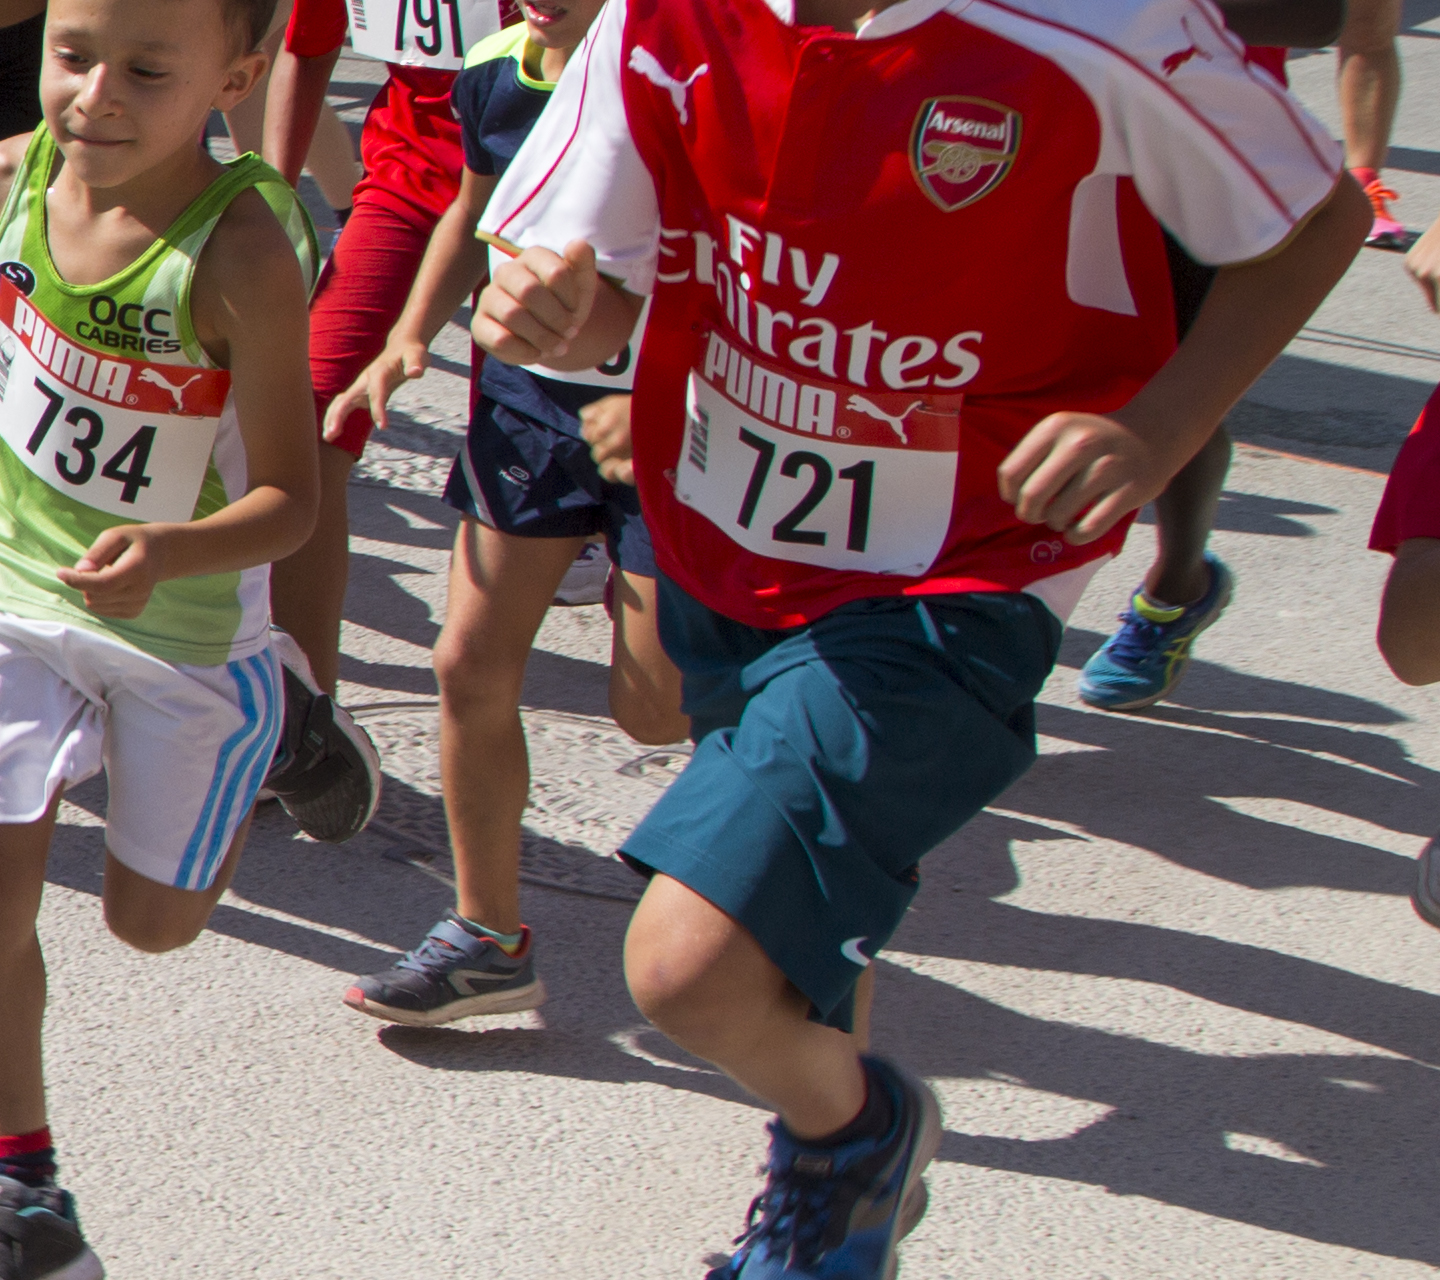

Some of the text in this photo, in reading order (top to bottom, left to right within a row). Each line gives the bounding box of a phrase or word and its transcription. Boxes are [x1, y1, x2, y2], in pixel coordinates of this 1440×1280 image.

[928, 111, 1006, 140] Arsenal
[726, 212, 840, 308] Fly
[13, 296, 132, 404] PUMA
[76, 321, 182, 354] CABRIES
[89, 294, 172, 338] OCC
[704, 330, 837, 438] PUMA
[25, 376, 157, 504] 734
[736, 426, 876, 553] 721
